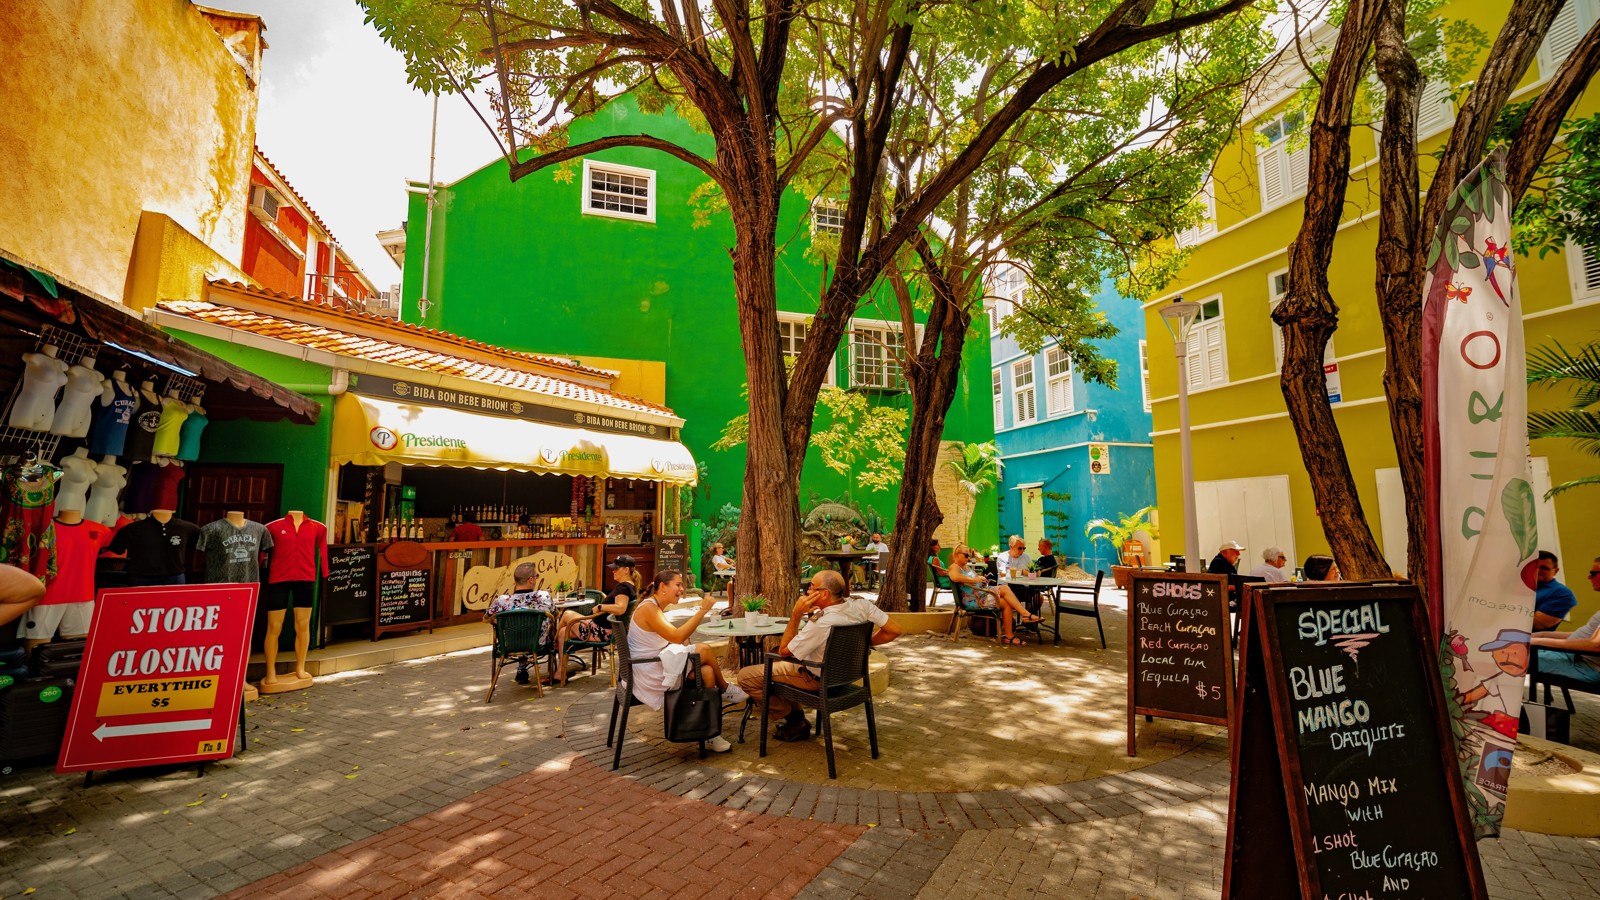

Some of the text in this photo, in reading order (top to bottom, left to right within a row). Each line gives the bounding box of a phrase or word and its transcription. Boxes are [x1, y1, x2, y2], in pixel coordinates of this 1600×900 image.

[413, 386, 435, 400] BIBA
[438, 391, 457, 403] BON
[458, 394, 480, 407] BEBE
[481, 398, 509, 411] BRION!
[586, 415, 601, 426] BIBA
[601, 418, 614, 428] BON
[614, 419, 628, 430] BEBE
[629, 422, 647, 433] BRION!
[401, 432, 467, 449] Presidente
[559, 449, 603, 462] Presidente
[664, 460, 697, 471] Presidente
[538, 555, 564, 574] Café
[130, 605, 221, 634] STORE
[1298, 602, 1390, 646] SPECIAL
[107, 645, 225, 677] CLOSING
[113, 680, 213, 695] EVERYTHIG
[1289, 664, 1346, 701] BLUE
[151, 697, 171, 708] $5
[1298, 699, 1371, 734] MANGO
[217, 742, 222, 751] 9
[1382, 875, 1410, 892] AND
